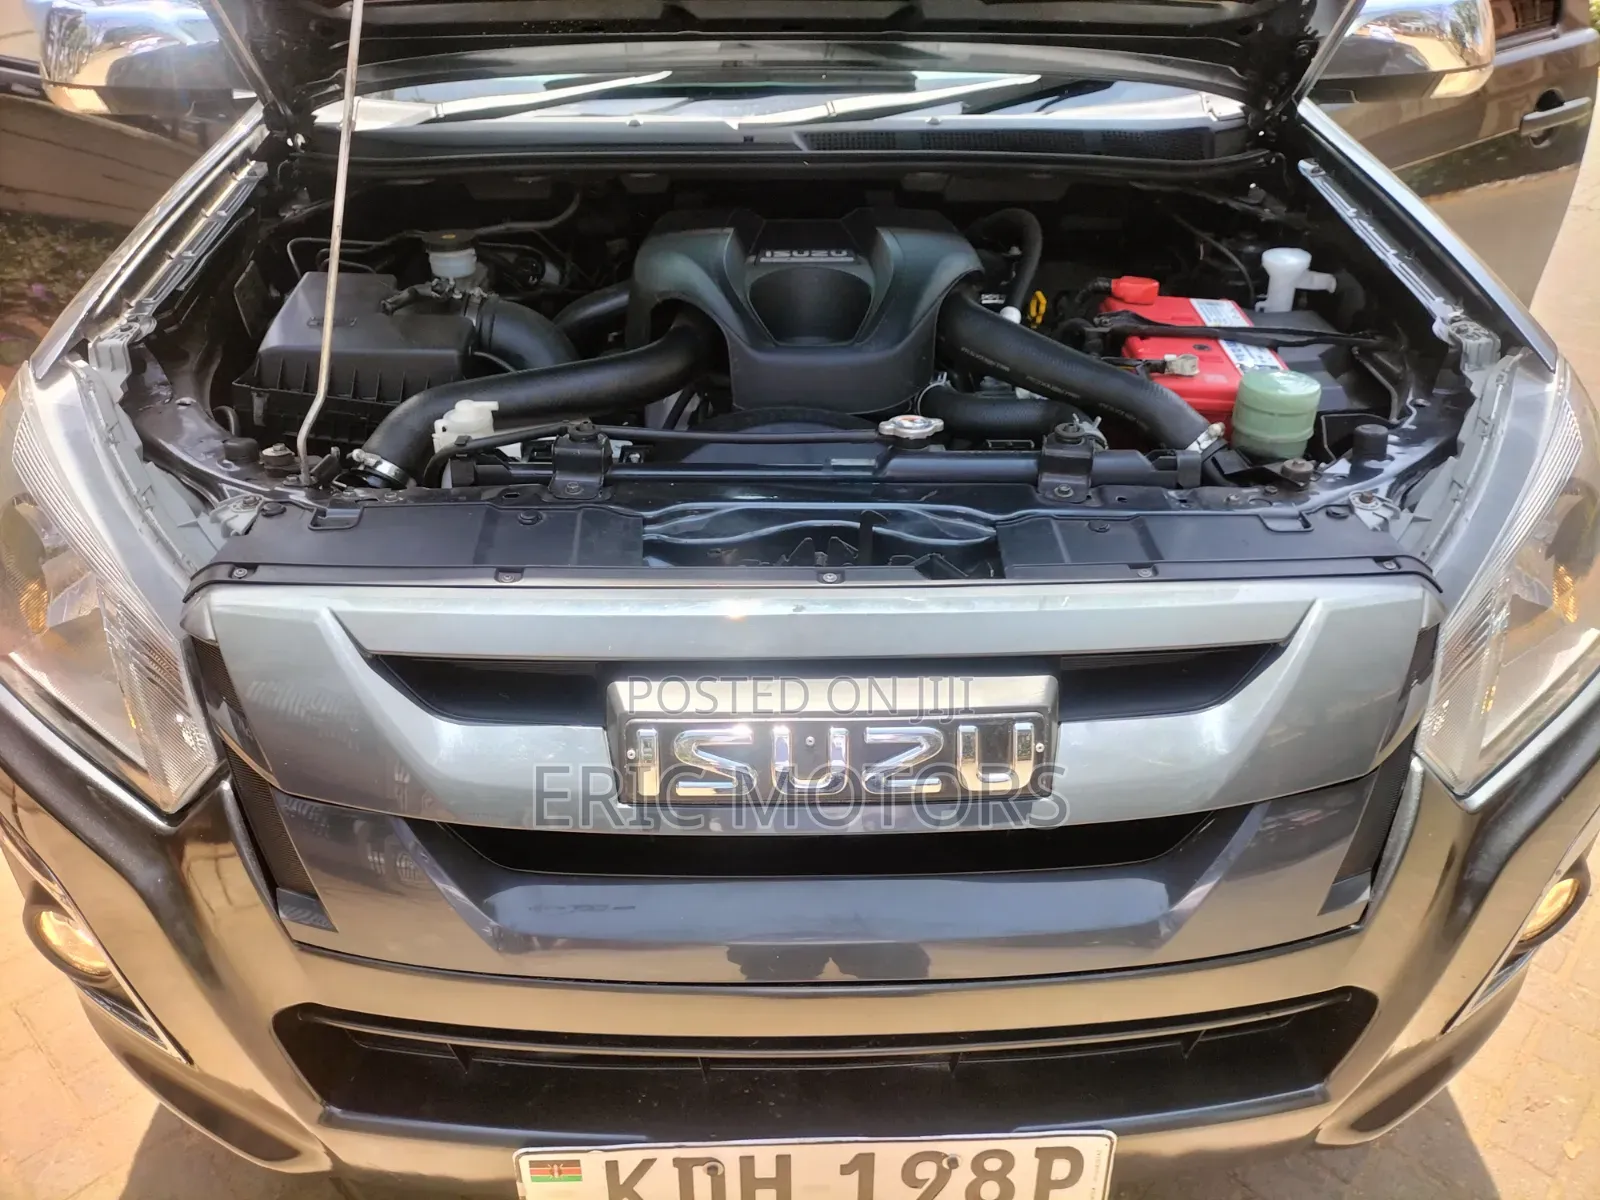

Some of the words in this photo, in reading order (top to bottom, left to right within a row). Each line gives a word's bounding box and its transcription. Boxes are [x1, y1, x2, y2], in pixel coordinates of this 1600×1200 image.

[765, 249, 848, 257] ISUZU
[636, 722, 1035, 796] ISUZU
[605, 1154, 791, 1200] KDH
[840, 1146, 1085, 1200] 198P
